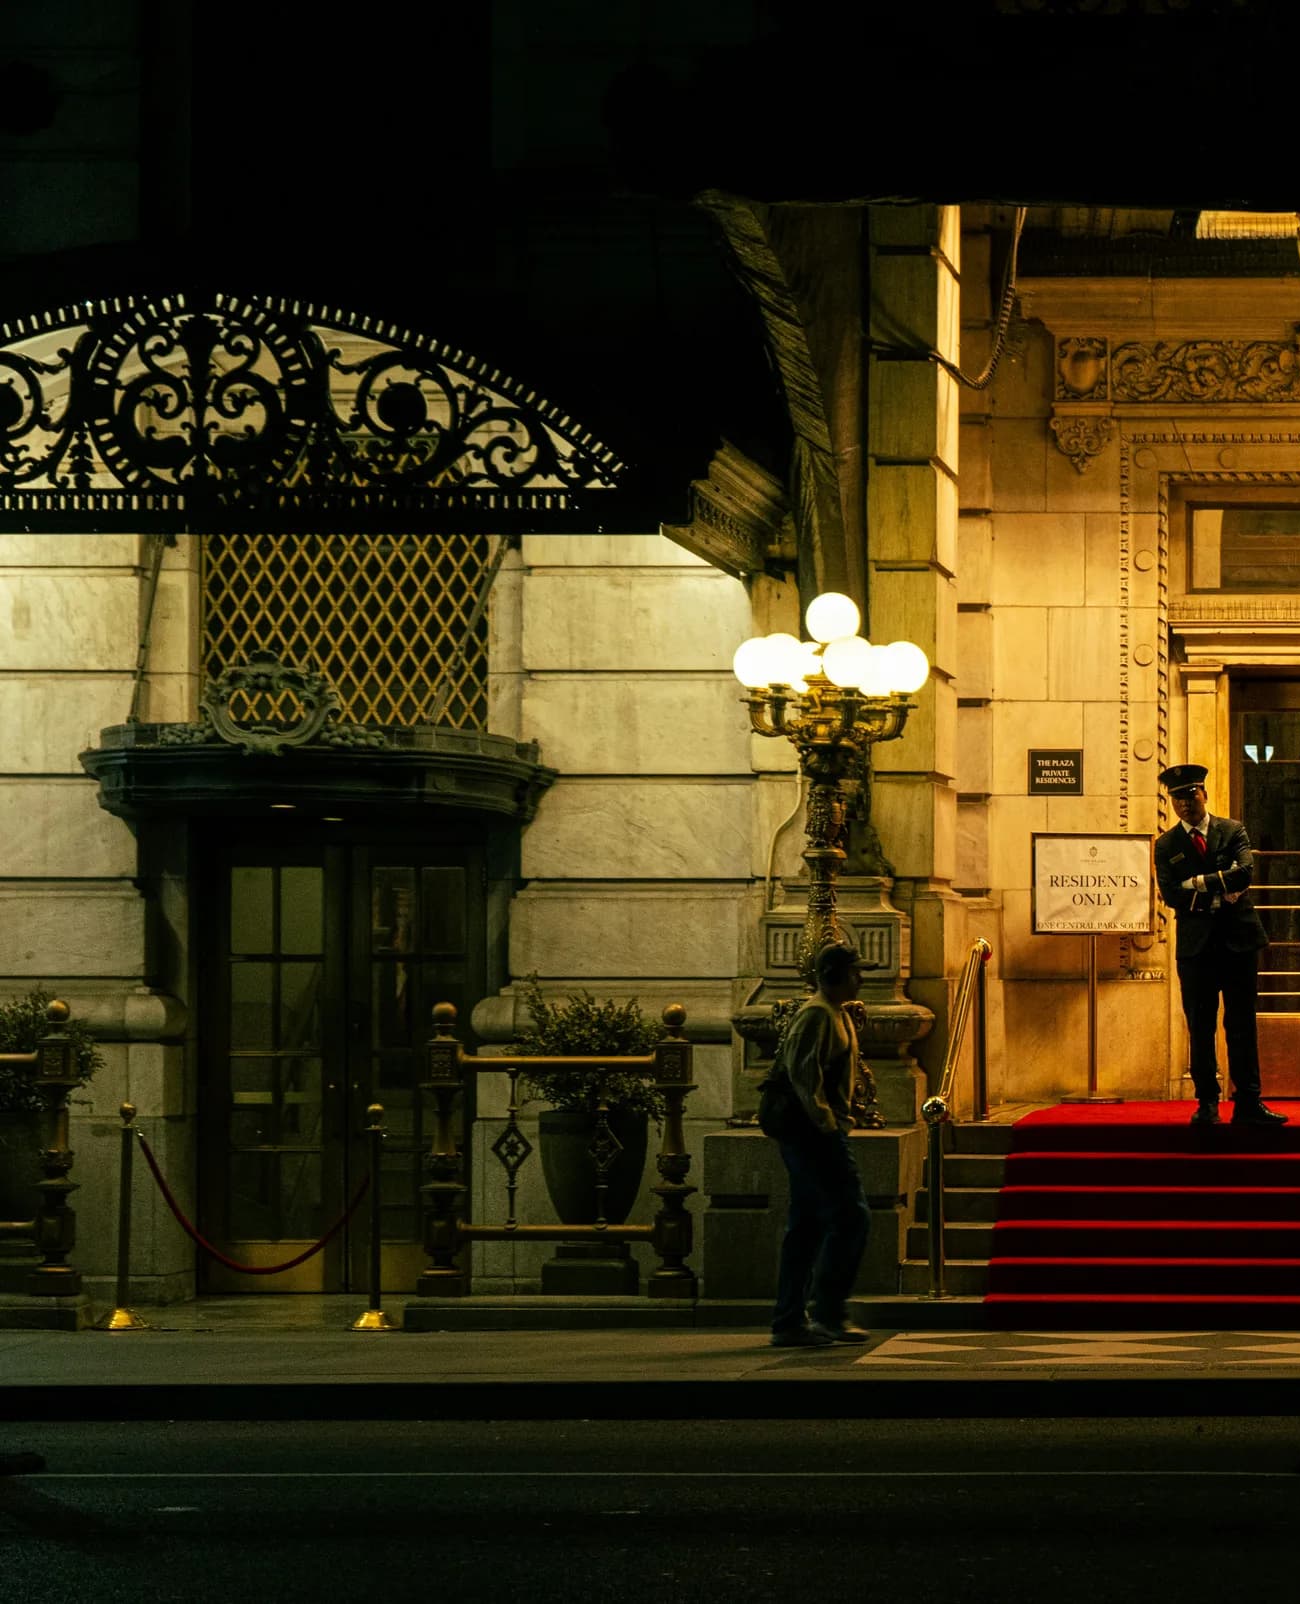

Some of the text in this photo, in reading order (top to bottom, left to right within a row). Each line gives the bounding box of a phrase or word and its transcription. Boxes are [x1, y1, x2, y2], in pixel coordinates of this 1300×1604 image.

[1036, 759, 1074, 767] THE PLAZA
[1041, 769, 1070, 777] PRIVATE
[1049, 874, 1139, 888] RESIDENTS
[1072, 892, 1116, 906] ONLY
[1037, 921, 1150, 930] ONE CENTRAL PARK SOUTH
